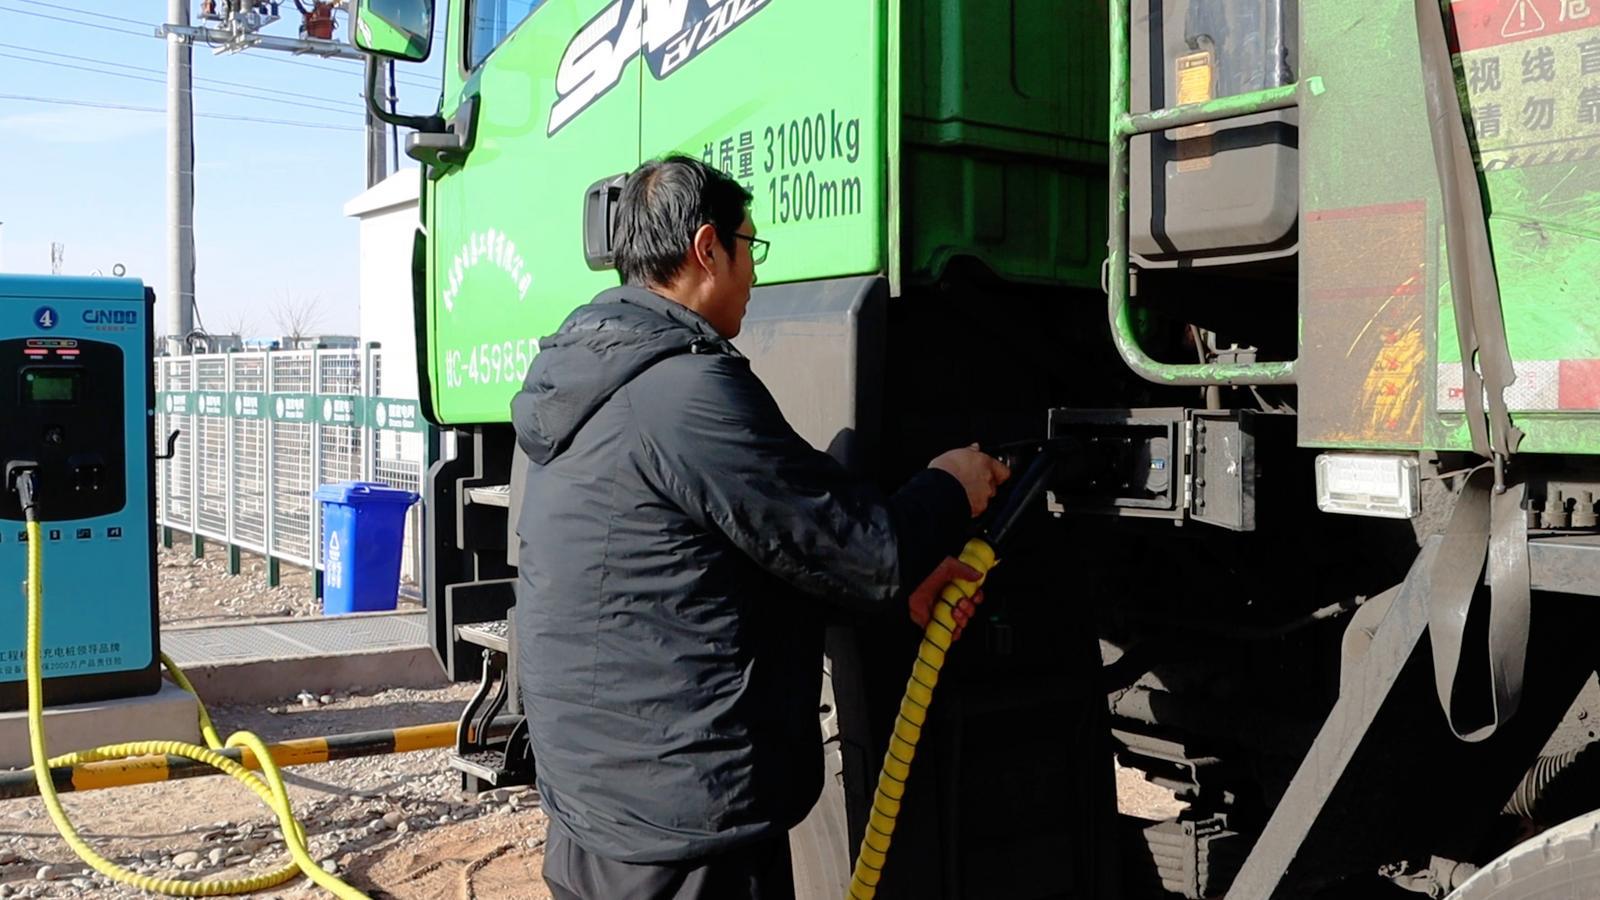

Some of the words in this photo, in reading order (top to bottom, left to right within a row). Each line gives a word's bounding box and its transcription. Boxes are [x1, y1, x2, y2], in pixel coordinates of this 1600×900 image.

[764, 109, 860, 173] 31000kg
[769, 171, 861, 224] 1500mm
[39, 309, 53, 327] 4
